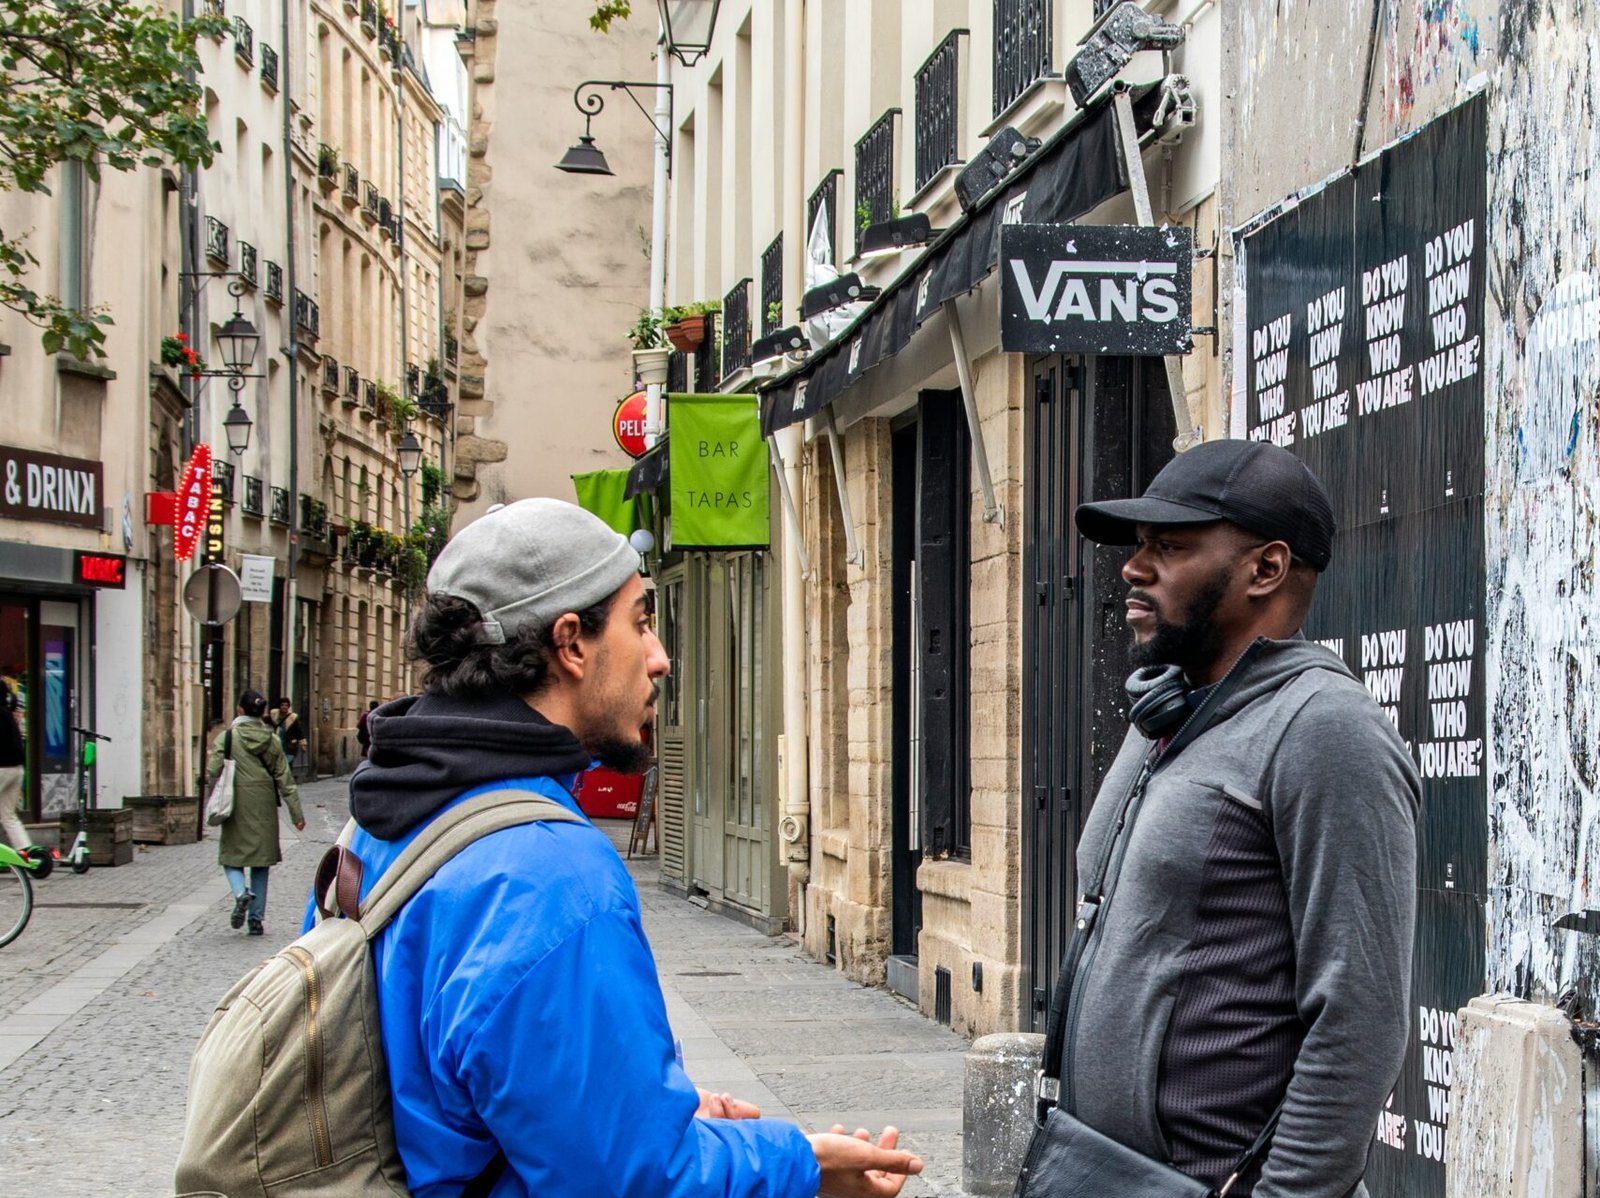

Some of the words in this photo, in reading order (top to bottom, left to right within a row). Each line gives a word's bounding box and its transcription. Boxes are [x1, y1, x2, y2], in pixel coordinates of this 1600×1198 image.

[1425, 236, 1443, 278] DO
[1444, 218, 1474, 266] YOU
[1010, 259, 1179, 323] VANS
[1362, 267, 1380, 306] DO
[1382, 254, 1408, 297] YOU
[1429, 260, 1471, 315] KNOW
[1307, 298, 1321, 334] DO
[1322, 286, 1345, 329] YOU
[1366, 293, 1405, 340] KNOW
[1432, 304, 1466, 351] WHO
[1253, 325, 1267, 360] DO
[1269, 313, 1291, 350] YOU
[1309, 323, 1342, 368] KNOW
[1369, 333, 1401, 375] WHO
[1256, 348, 1289, 391] KNOW
[1312, 361, 1337, 400] WHO
[1418, 352, 1445, 396] YOU
[1445, 335, 1480, 386] ARE?
[1259, 384, 1284, 422] WHO
[1356, 378, 1381, 416] YOU
[1382, 365, 1414, 409] ARE?
[1270, 411, 1296, 447] ARE?
[1301, 400, 1322, 439] YOU
[1322, 390, 1349, 432] ARE?
[698, 440, 739, 458] BAR
[5, 459, 21, 505] &
[181, 467, 205, 537] TABAC
[687, 491, 752, 509] TAPAS
[1362, 633, 1378, 668] DO
[1380, 629, 1406, 666] YOU
[1425, 624, 1444, 662] DO
[1445, 619, 1474, 658] YOU
[1364, 667, 1404, 703] KNOW
[1428, 660, 1472, 700] KNOW
[1431, 701, 1467, 738] WHO
[1419, 742, 1446, 778] YOU
[1446, 738, 1482, 777] ARE?
[1419, 1006, 1438, 1044] DO
[1439, 1010, 1457, 1048] YO
[1423, 1046, 1453, 1086] KNO
[1428, 1085, 1451, 1124] WH
[1414, 1119, 1442, 1163] YOU
